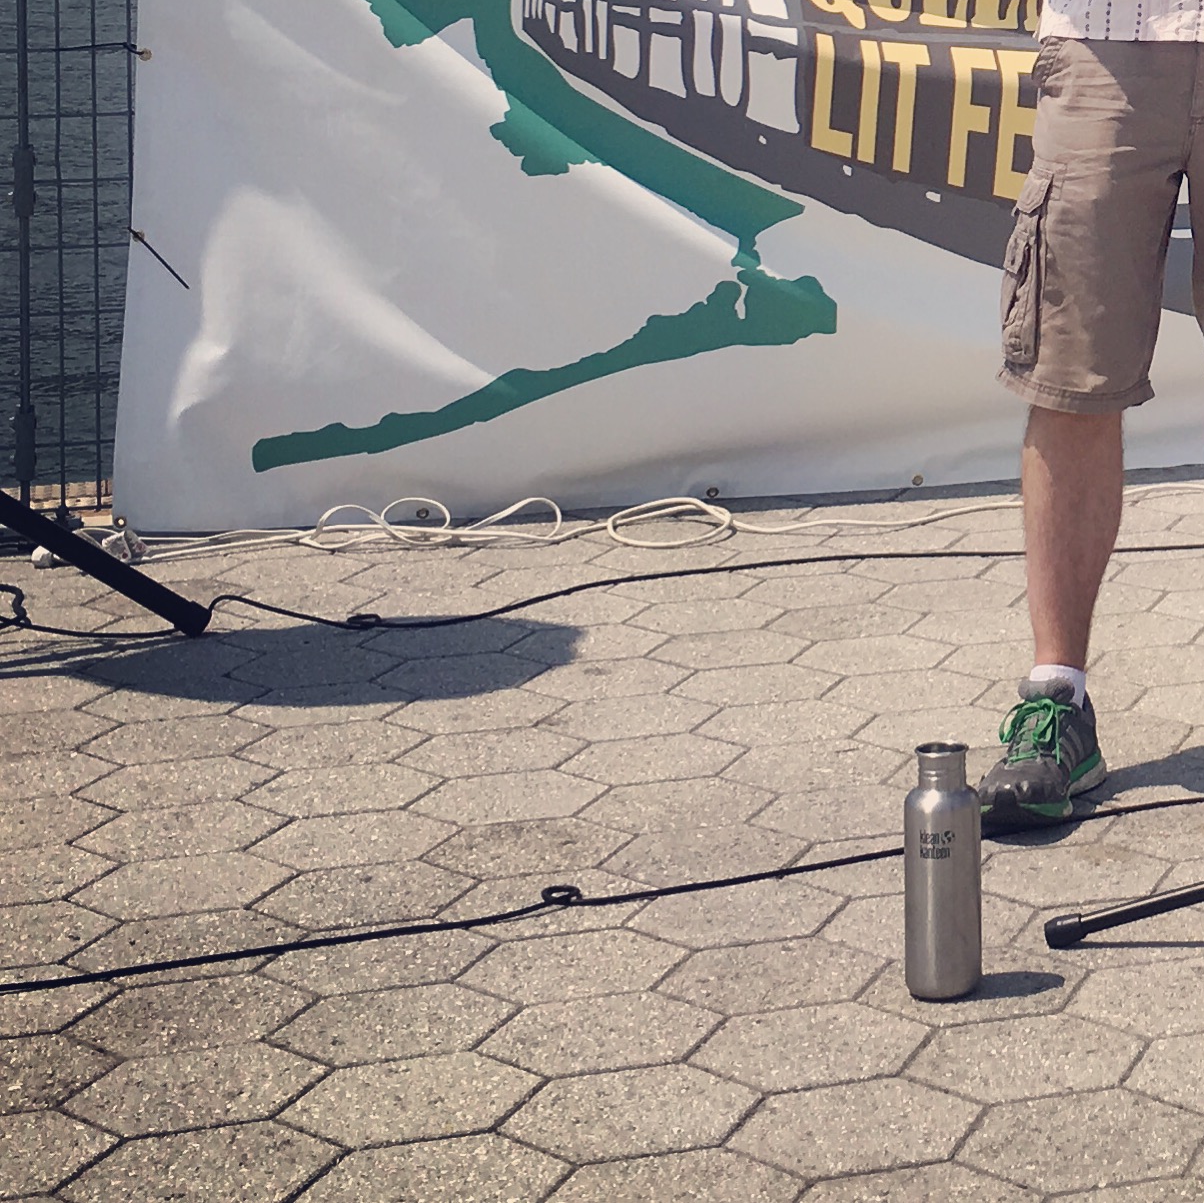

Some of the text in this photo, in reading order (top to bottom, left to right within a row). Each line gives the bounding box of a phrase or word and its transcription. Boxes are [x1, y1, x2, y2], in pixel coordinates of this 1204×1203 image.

[811, 33, 1042, 201] LIT FE
[920, 845, 950, 859] kanteen
